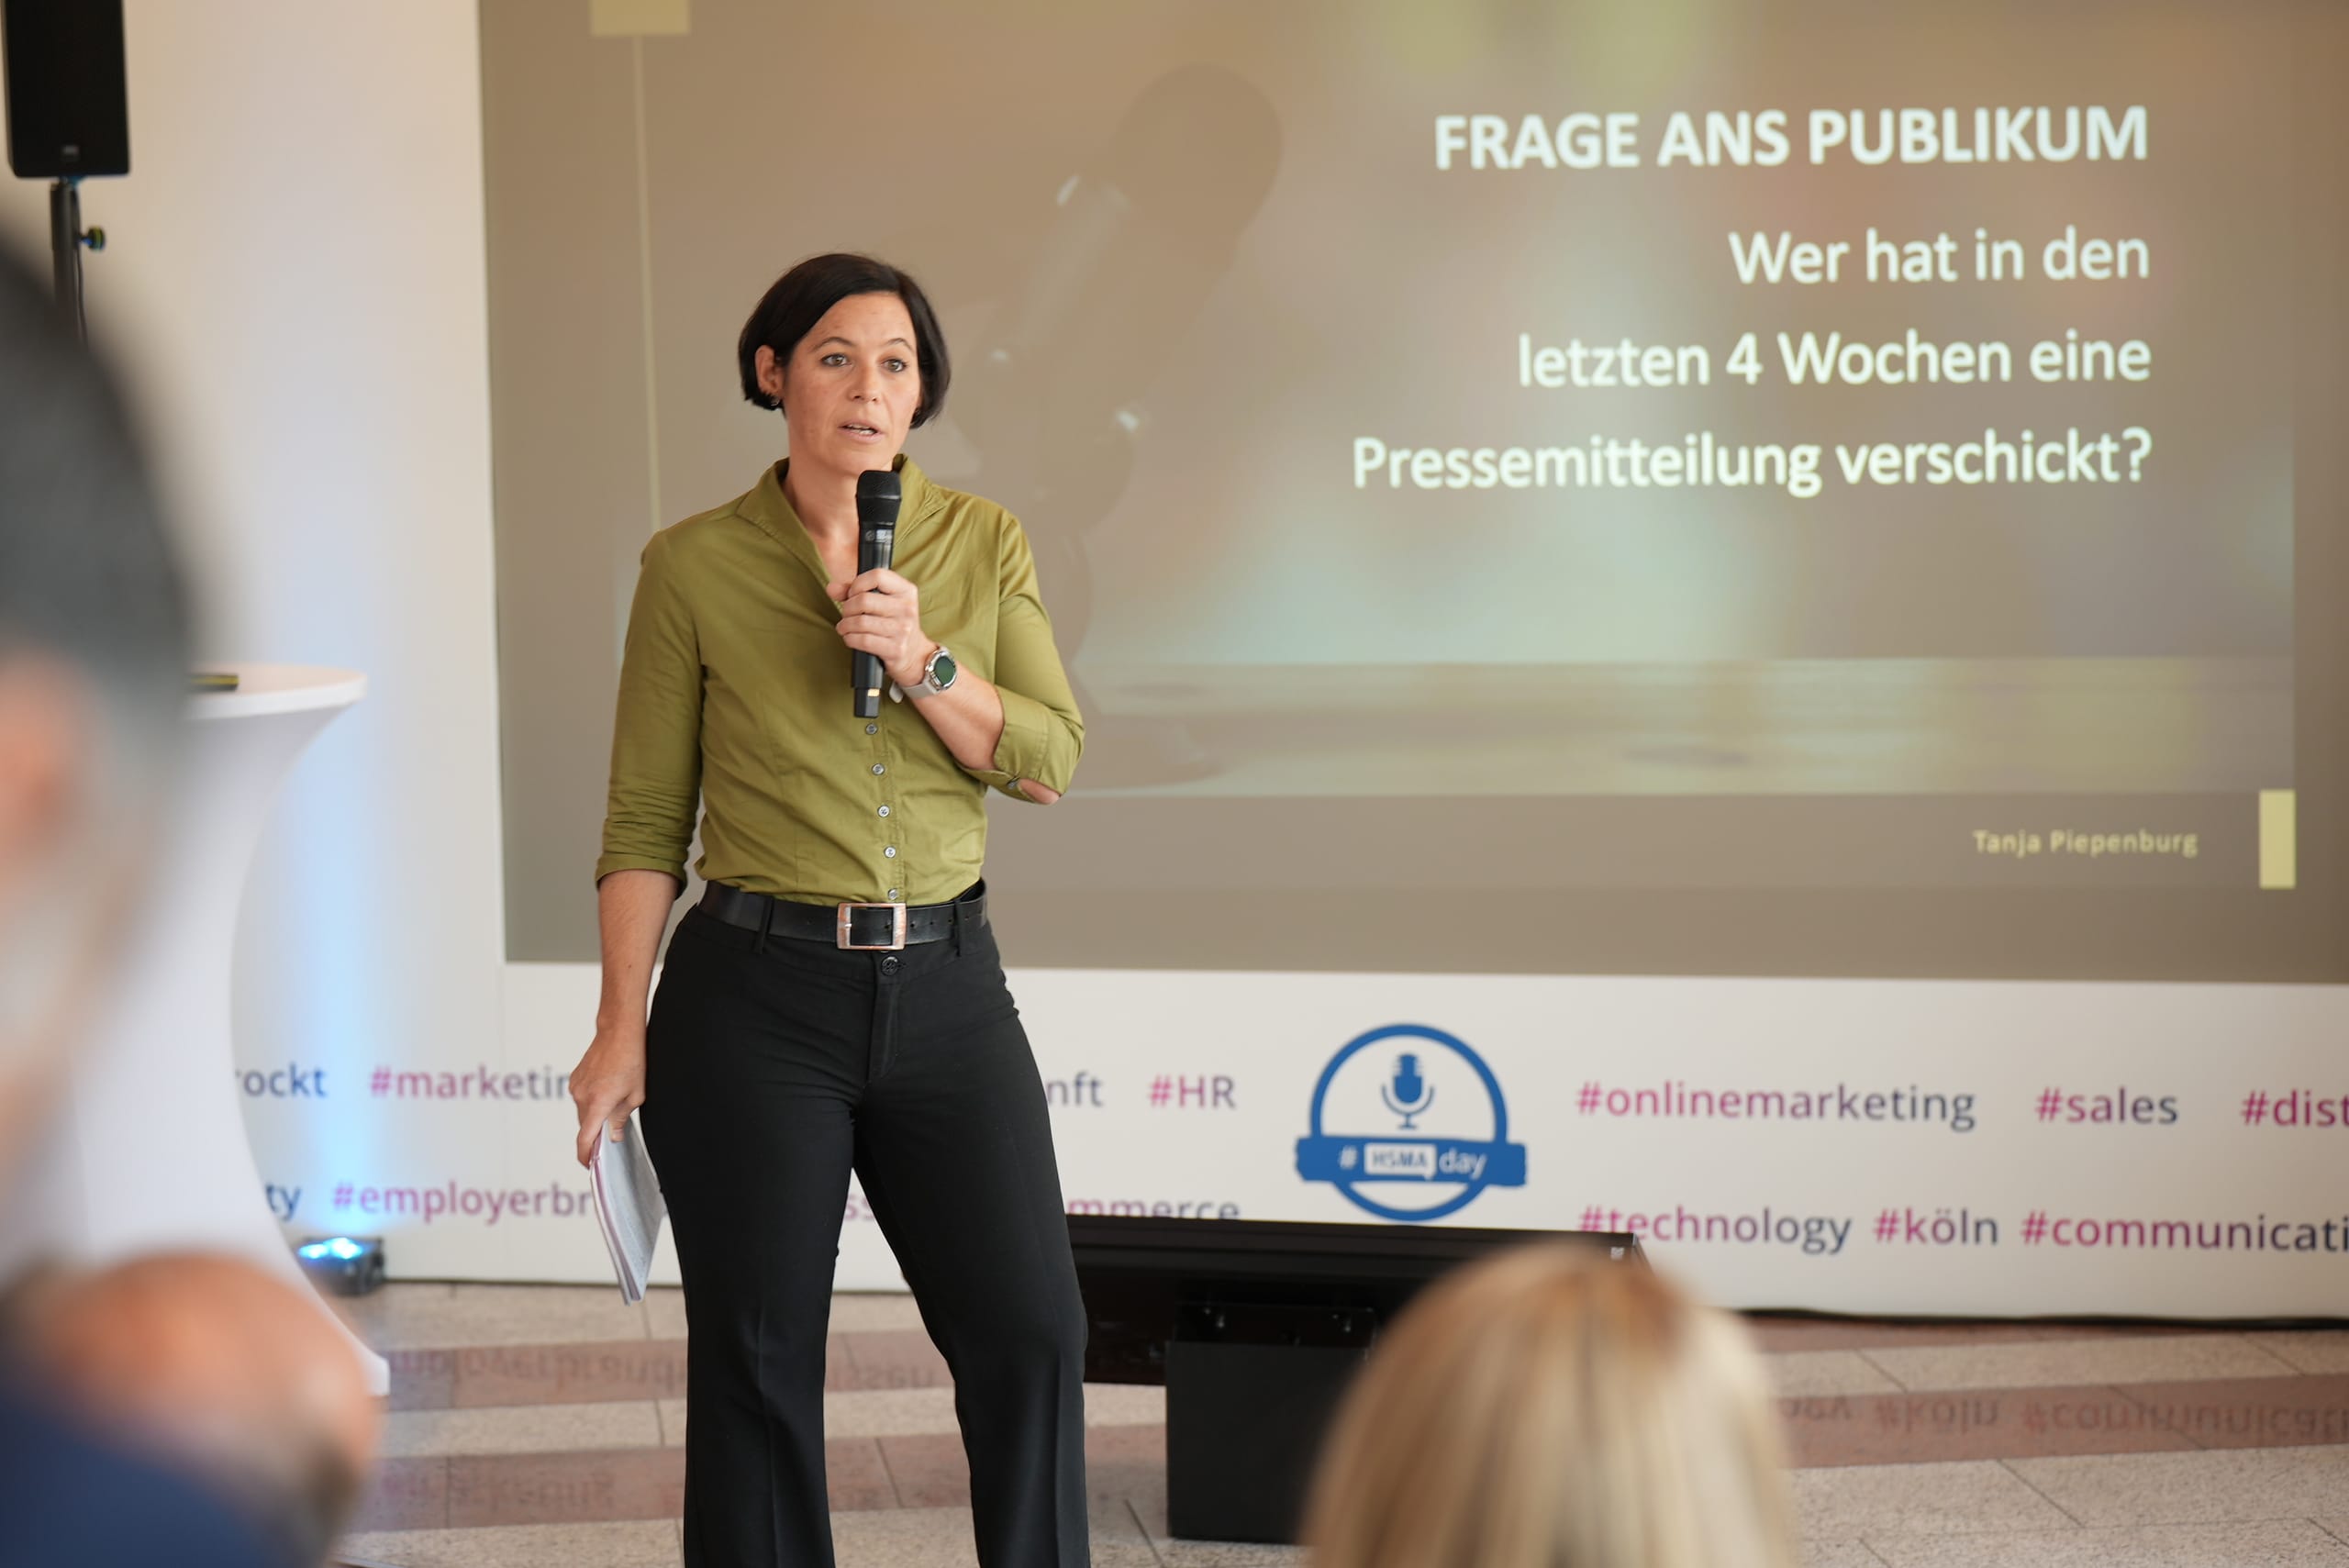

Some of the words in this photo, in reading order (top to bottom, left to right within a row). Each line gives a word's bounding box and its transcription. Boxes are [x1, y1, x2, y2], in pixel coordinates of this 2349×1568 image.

[1434, 111, 1642, 171] FRAGE
[1655, 109, 1790, 168] ANS
[1808, 105, 2149, 165] PUBLIKUM
[1727, 230, 1851, 284] Wer
[1865, 227, 1959, 284] hat
[1974, 227, 2025, 282] in
[2042, 223, 2151, 282] den
[1518, 332, 1709, 389] letzten
[1724, 331, 1764, 385] 4
[1776, 328, 2012, 385] Wochen
[2028, 327, 2152, 383] eine
[1353, 430, 1822, 498] Pressemitteilung
[1833, 426, 2153, 488] verschickt?
[1972, 828, 2042, 859] Tanja
[2048, 828, 2199, 859] Piepenburg
[1148, 1074, 1237, 1109] #HR
[1577, 1080, 1977, 1134] #onlinemarketing
[2036, 1086, 2180, 1127] #sales
[1372, 1151, 1428, 1168] HSMA
[1438, 1147, 1487, 1181] day
[1580, 1204, 1854, 1257] #technology
[1874, 1207, 1998, 1246] #köln
[2021, 1210, 2349, 1254] #communicati
